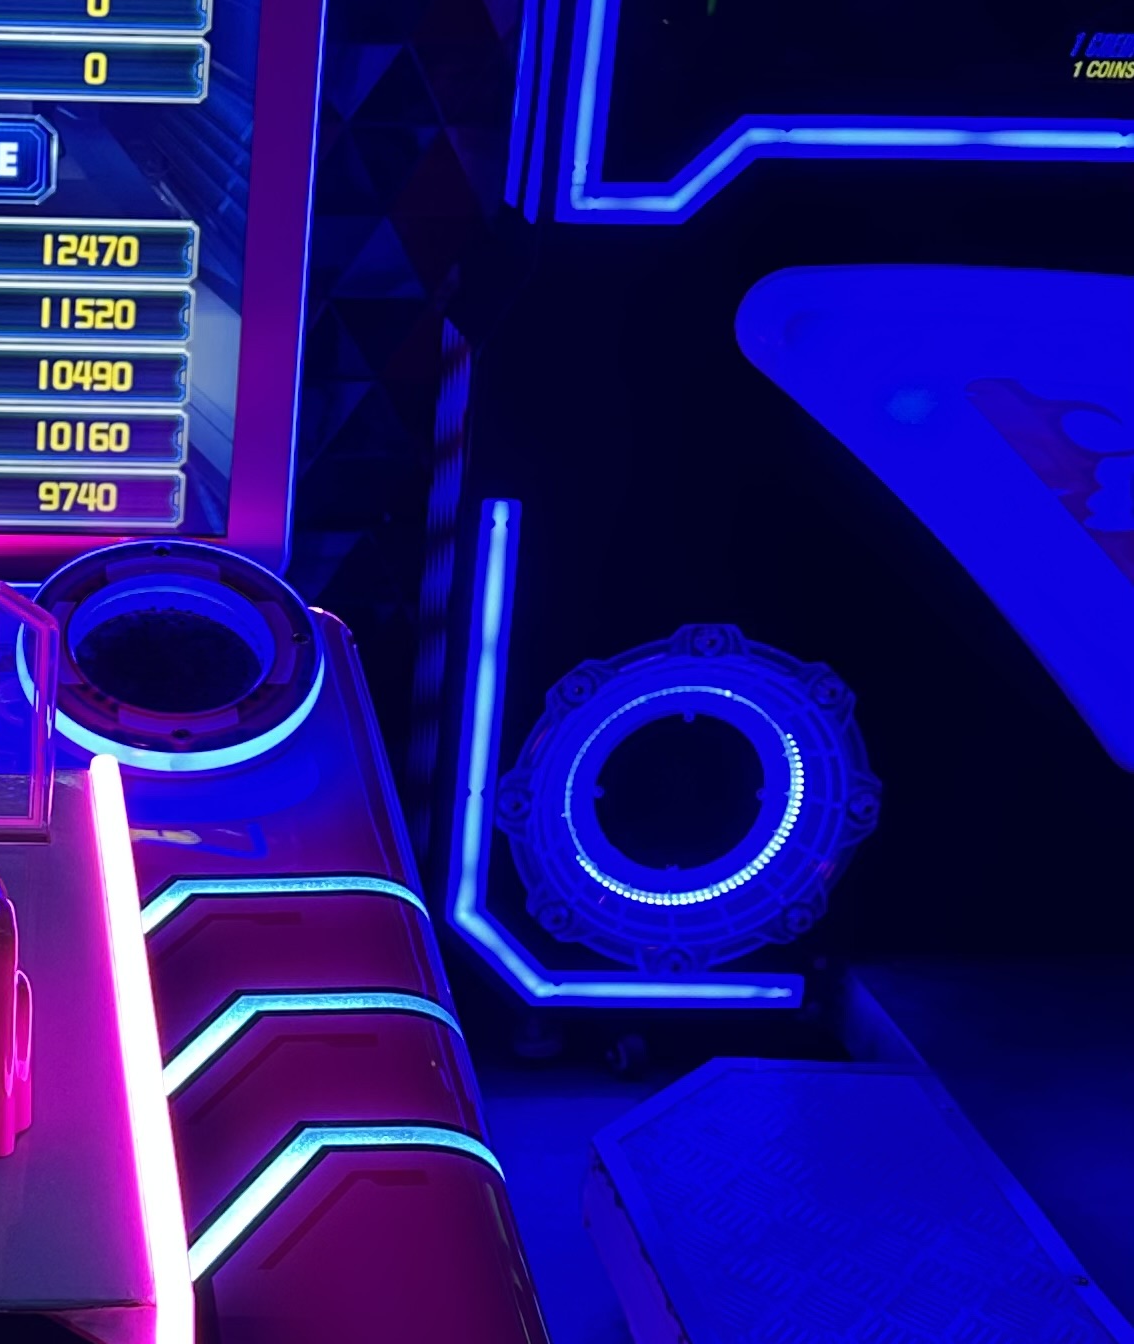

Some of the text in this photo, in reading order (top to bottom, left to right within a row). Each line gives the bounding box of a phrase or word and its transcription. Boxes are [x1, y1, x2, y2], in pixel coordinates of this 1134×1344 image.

[84, 52, 107, 85] 0
[43, 234, 139, 267] 12470
[41, 298, 136, 330] 11520
[38, 360, 133, 391] 10490
[36, 421, 130, 452] 10160
[38, 481, 117, 511] 9740
